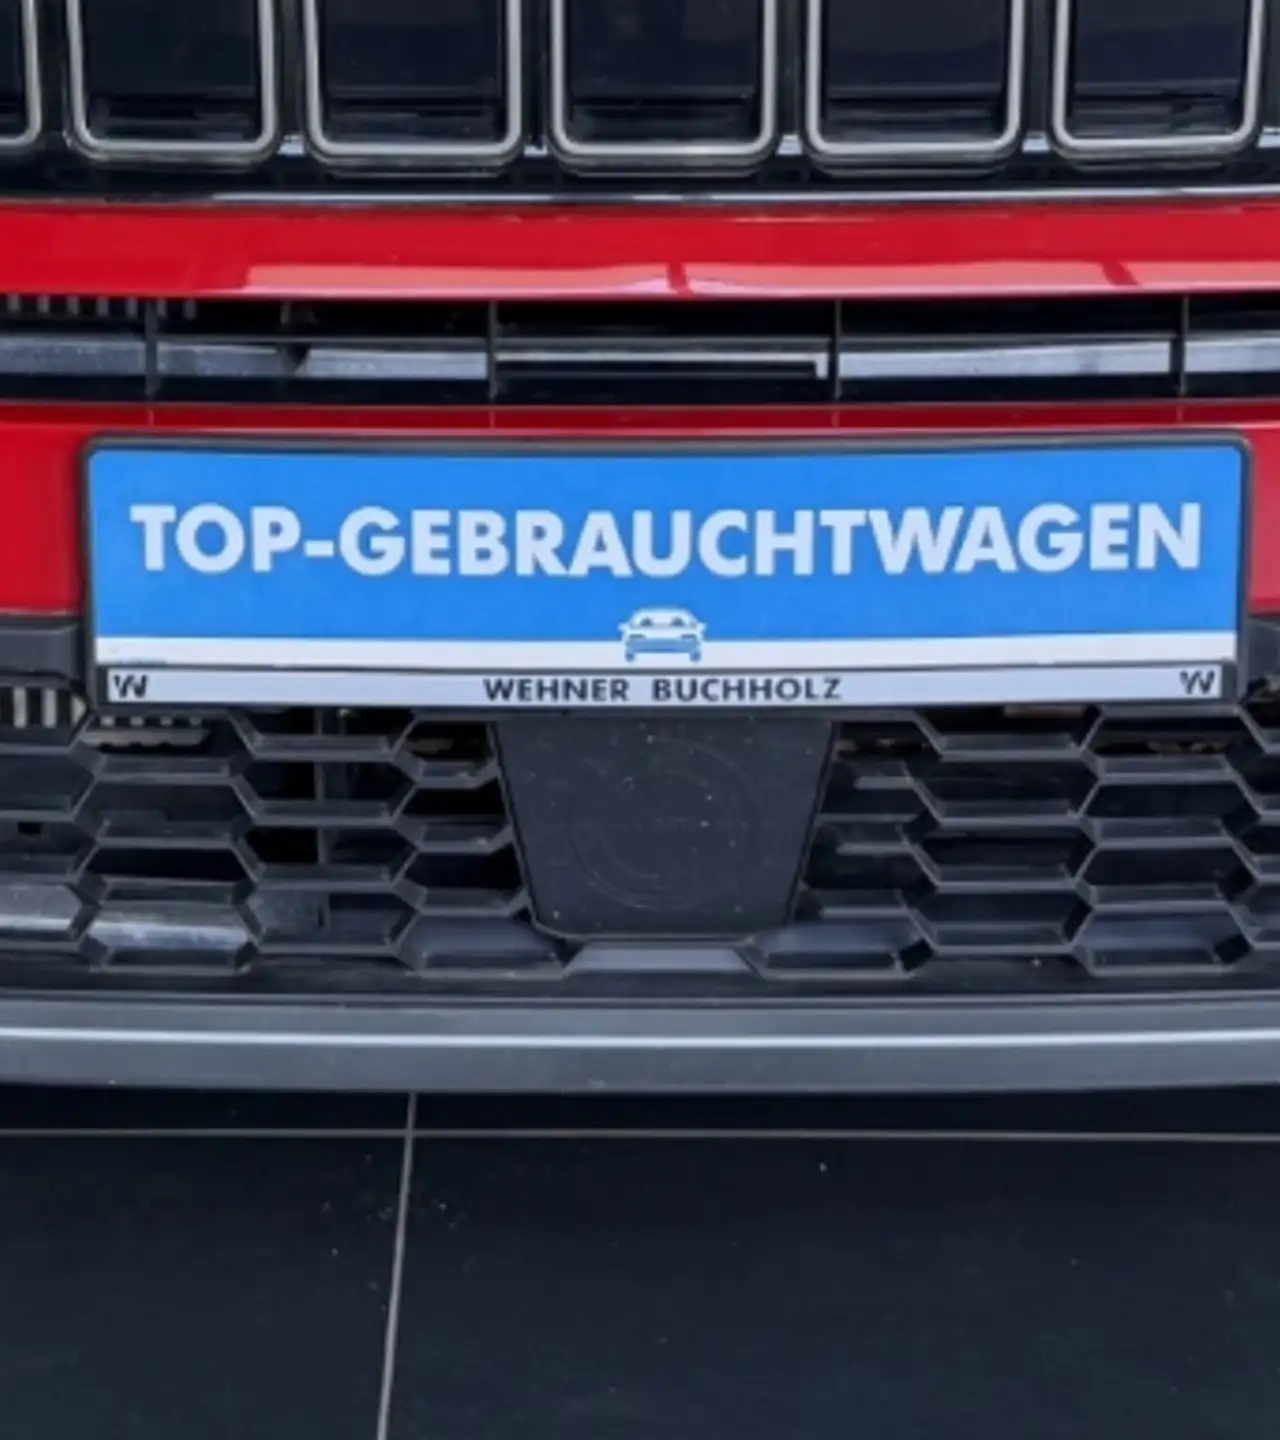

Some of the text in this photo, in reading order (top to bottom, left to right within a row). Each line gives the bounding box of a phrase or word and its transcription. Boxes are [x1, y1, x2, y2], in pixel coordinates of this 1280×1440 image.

[129, 501, 1203, 578] TOP-GEBRAUCHTWAGEN
[483, 677, 842, 702] WEHNER BUCHHOLZ
